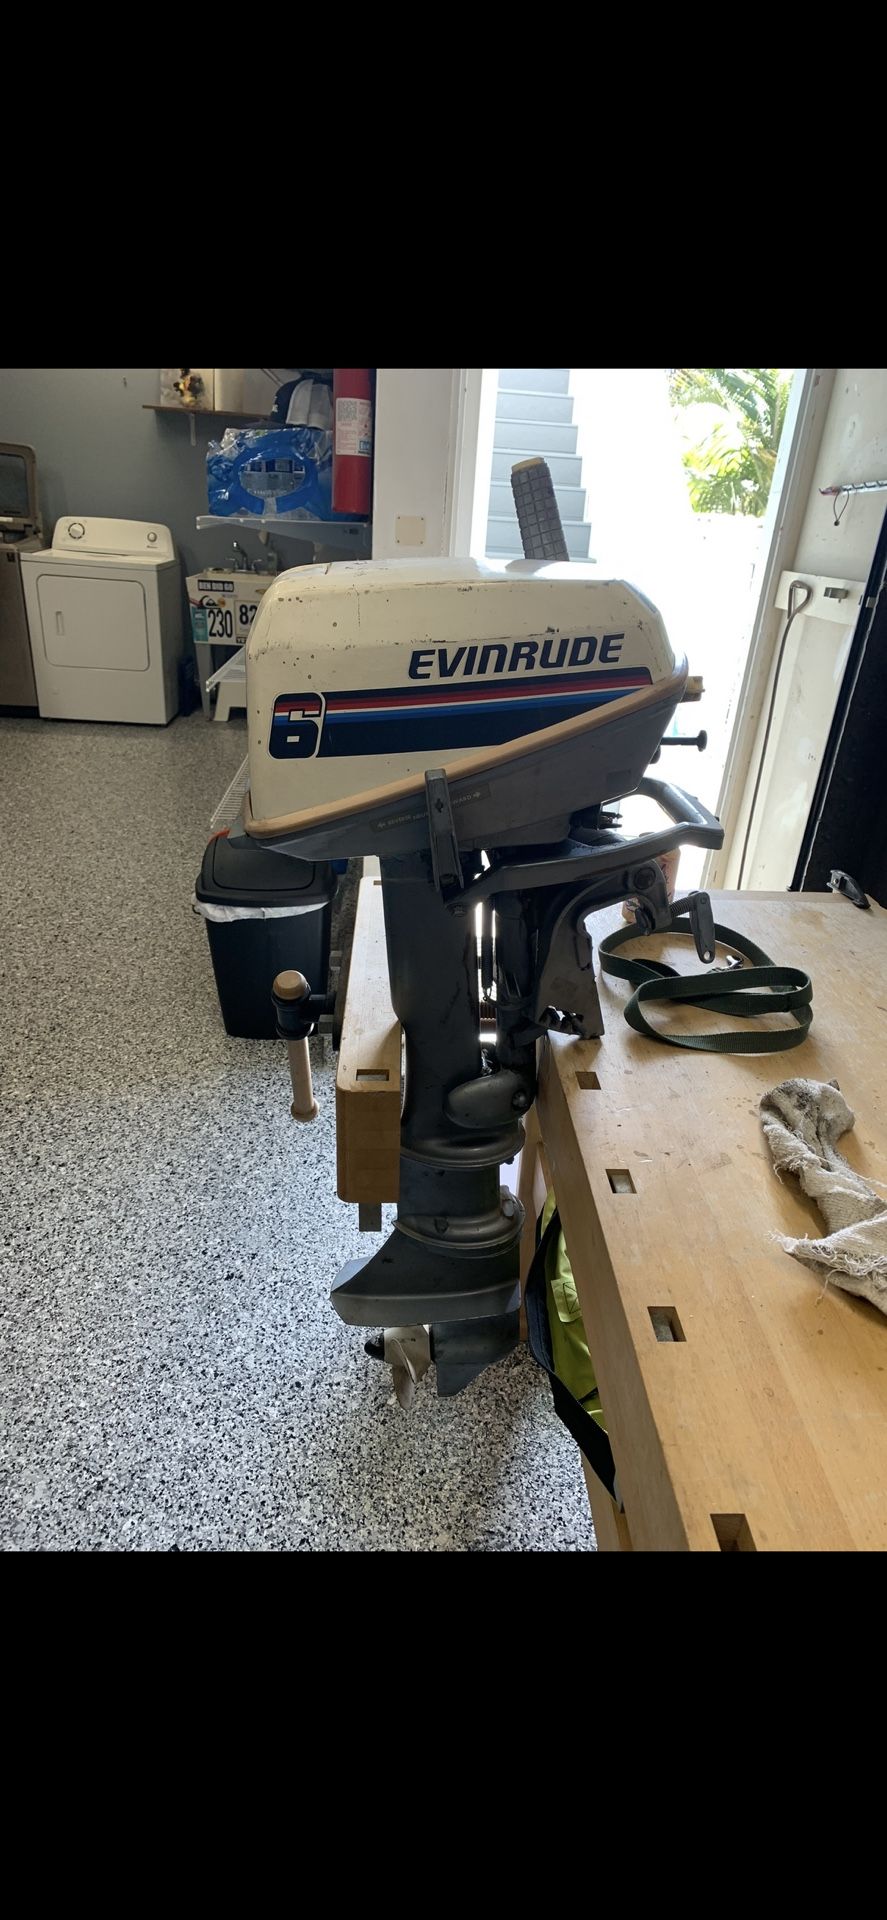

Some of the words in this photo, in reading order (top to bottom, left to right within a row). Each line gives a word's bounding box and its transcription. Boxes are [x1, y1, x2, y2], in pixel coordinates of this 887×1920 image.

[208, 609, 233, 638] 230
[408, 633, 625, 680] EVINRUDE
[268, 691, 322, 759] 6
